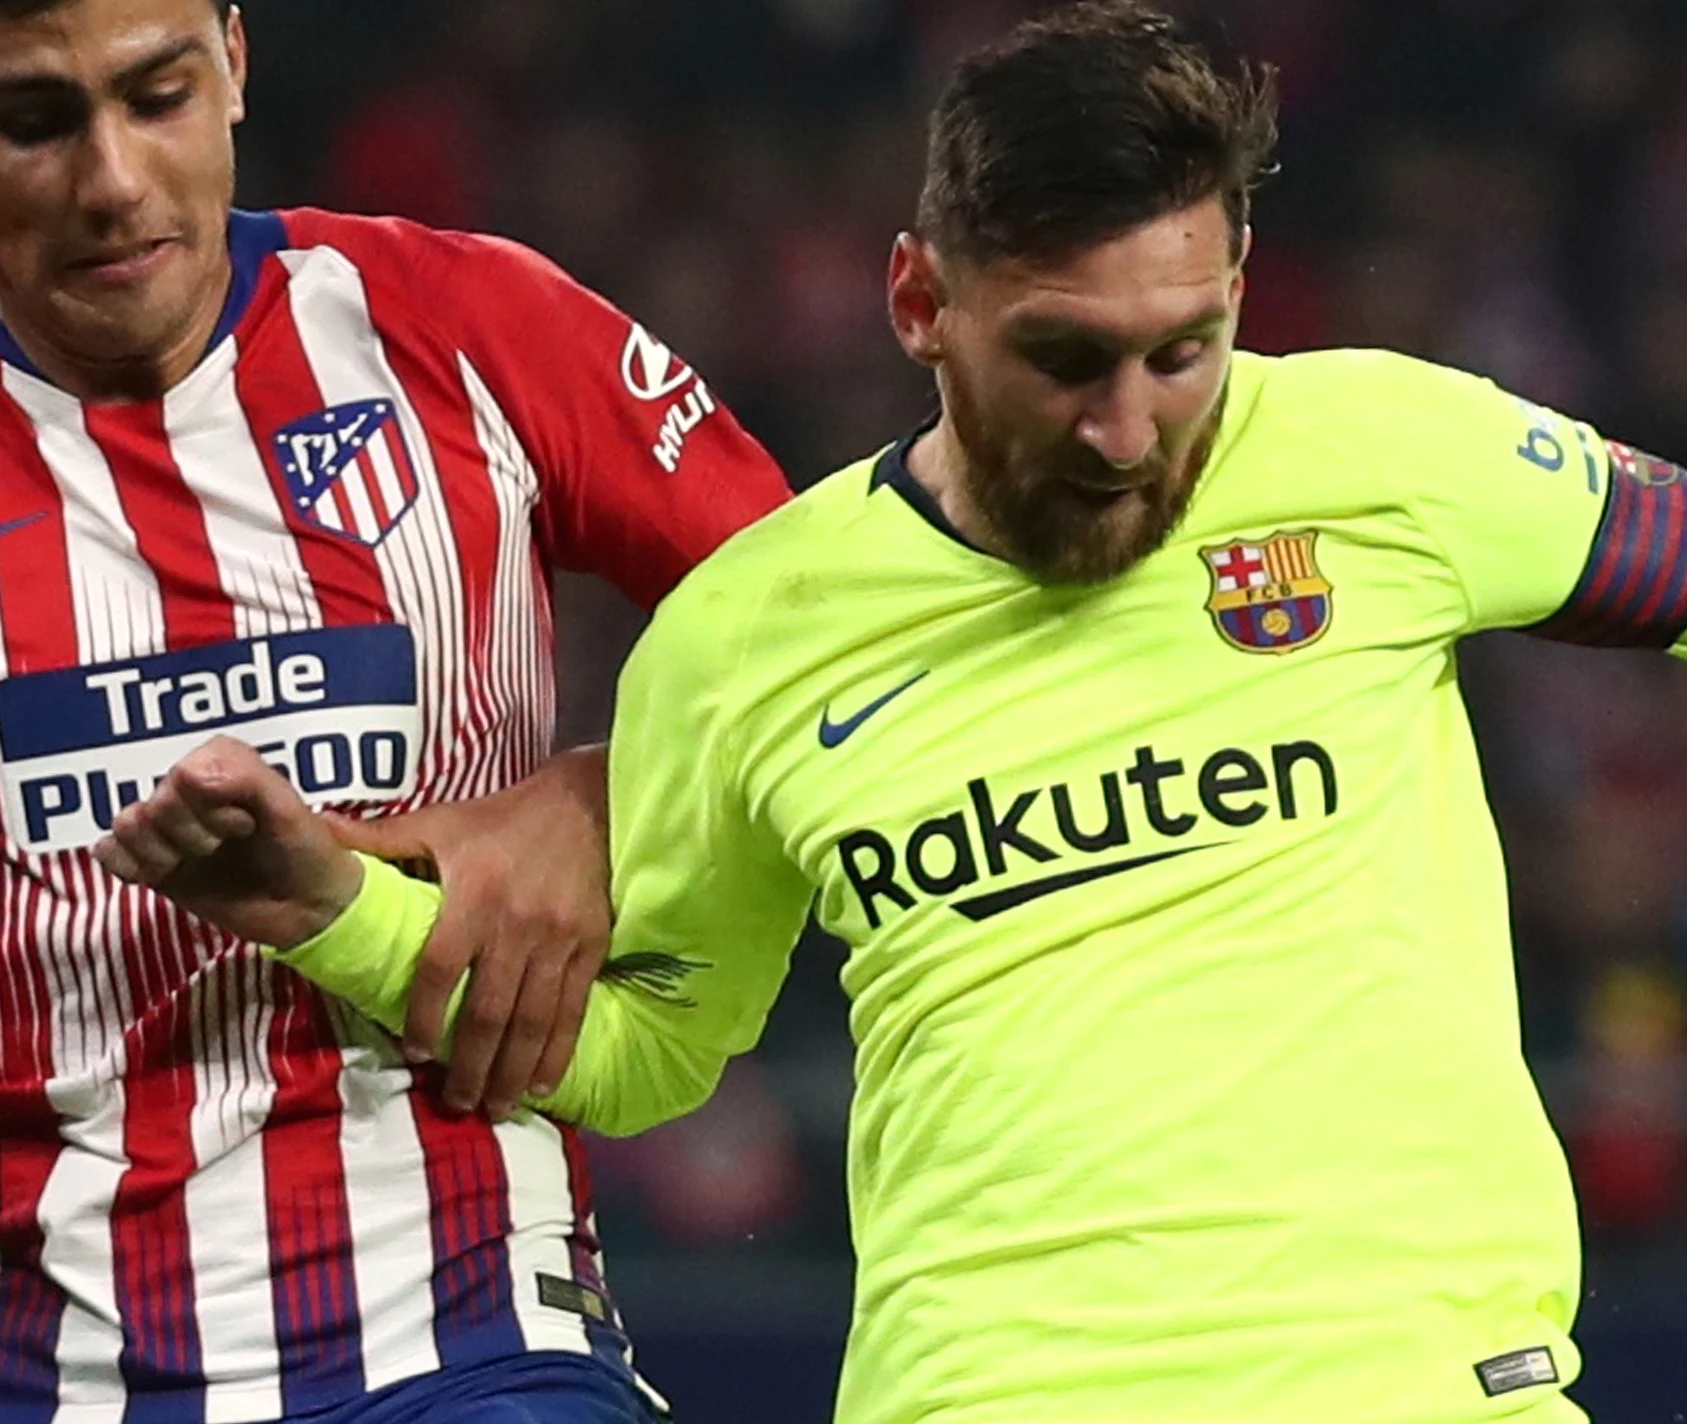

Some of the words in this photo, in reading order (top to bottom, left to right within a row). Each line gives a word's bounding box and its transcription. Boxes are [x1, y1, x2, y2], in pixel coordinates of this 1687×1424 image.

[86, 641, 326, 736] Trade
[20, 731, 407, 843] Pl00
[838, 740, 1338, 930] Rakuten
